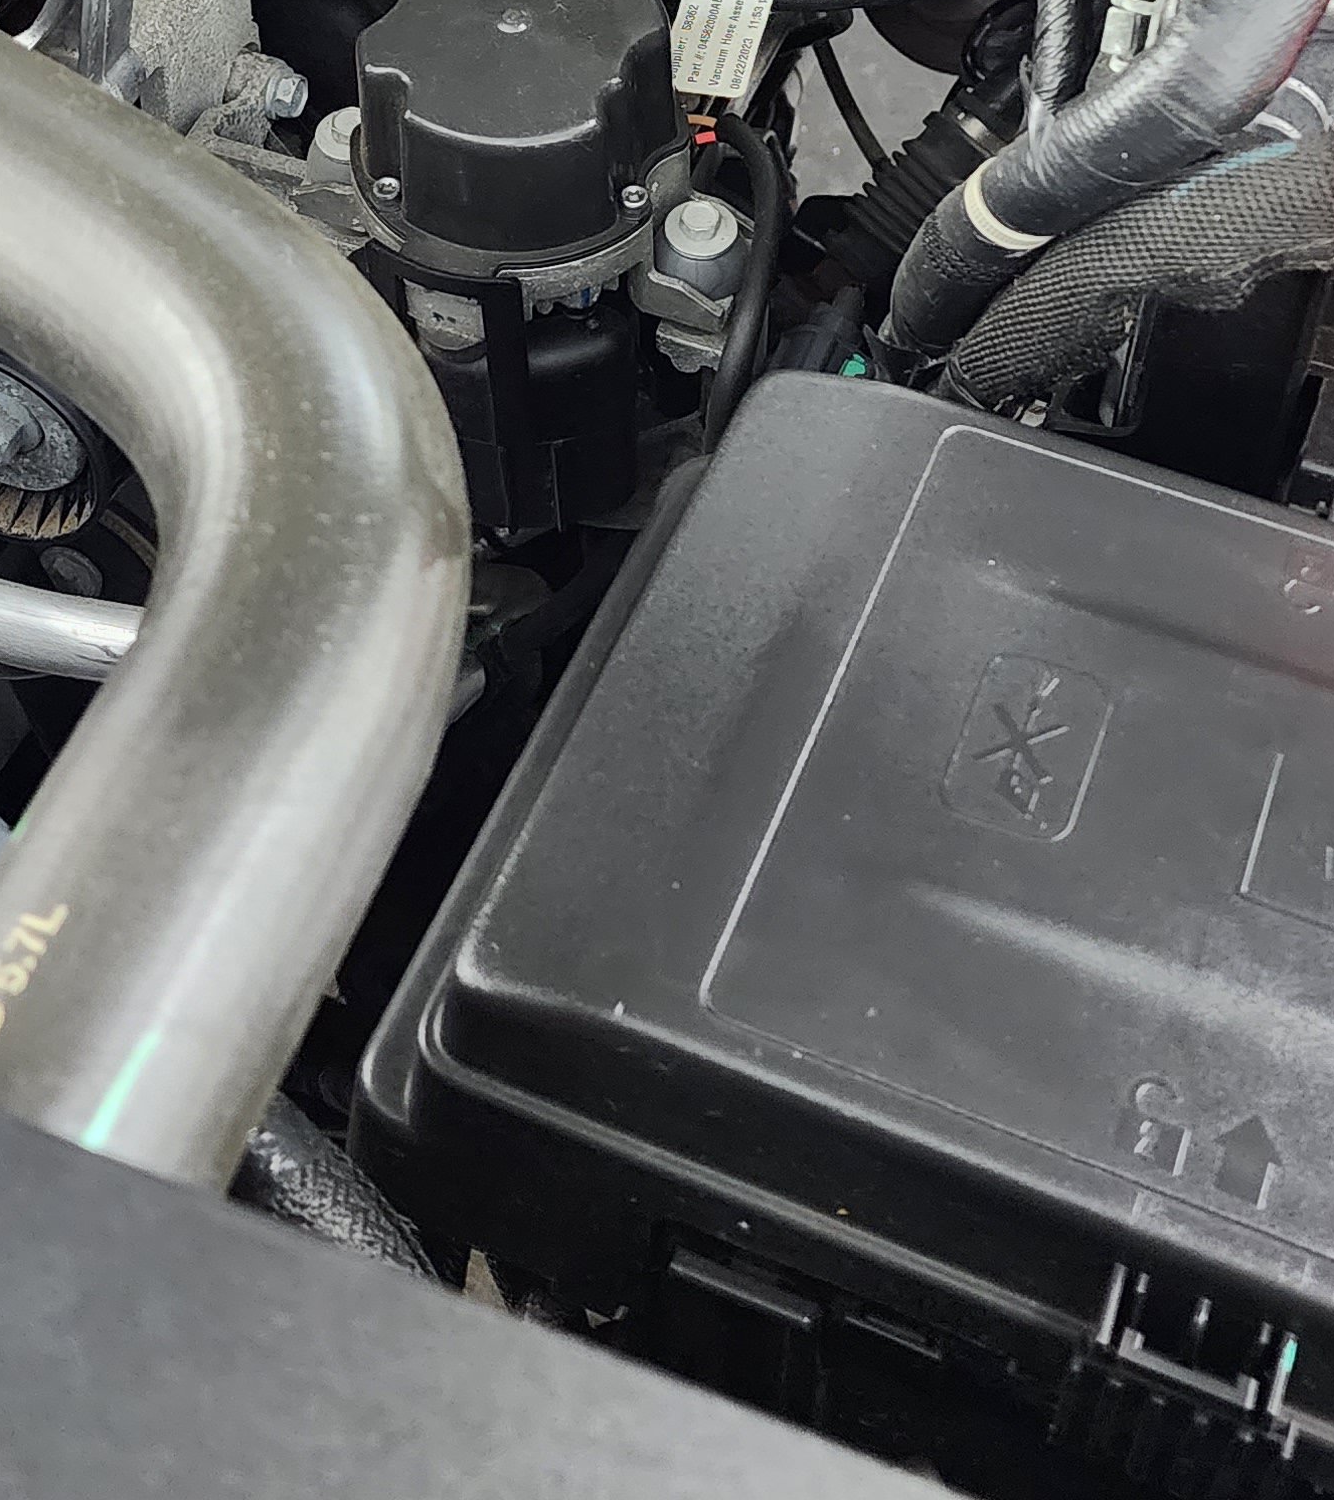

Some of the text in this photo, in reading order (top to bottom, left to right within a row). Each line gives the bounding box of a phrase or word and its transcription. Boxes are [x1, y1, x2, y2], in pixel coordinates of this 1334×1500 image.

[687, 58, 703, 84] Part
[708, 46, 729, 87] Vacuum
[720, 23, 737, 45] Hose
[730, 37, 754, 90] 08/22/2023
[748, 4, 765, 30] 11:53
